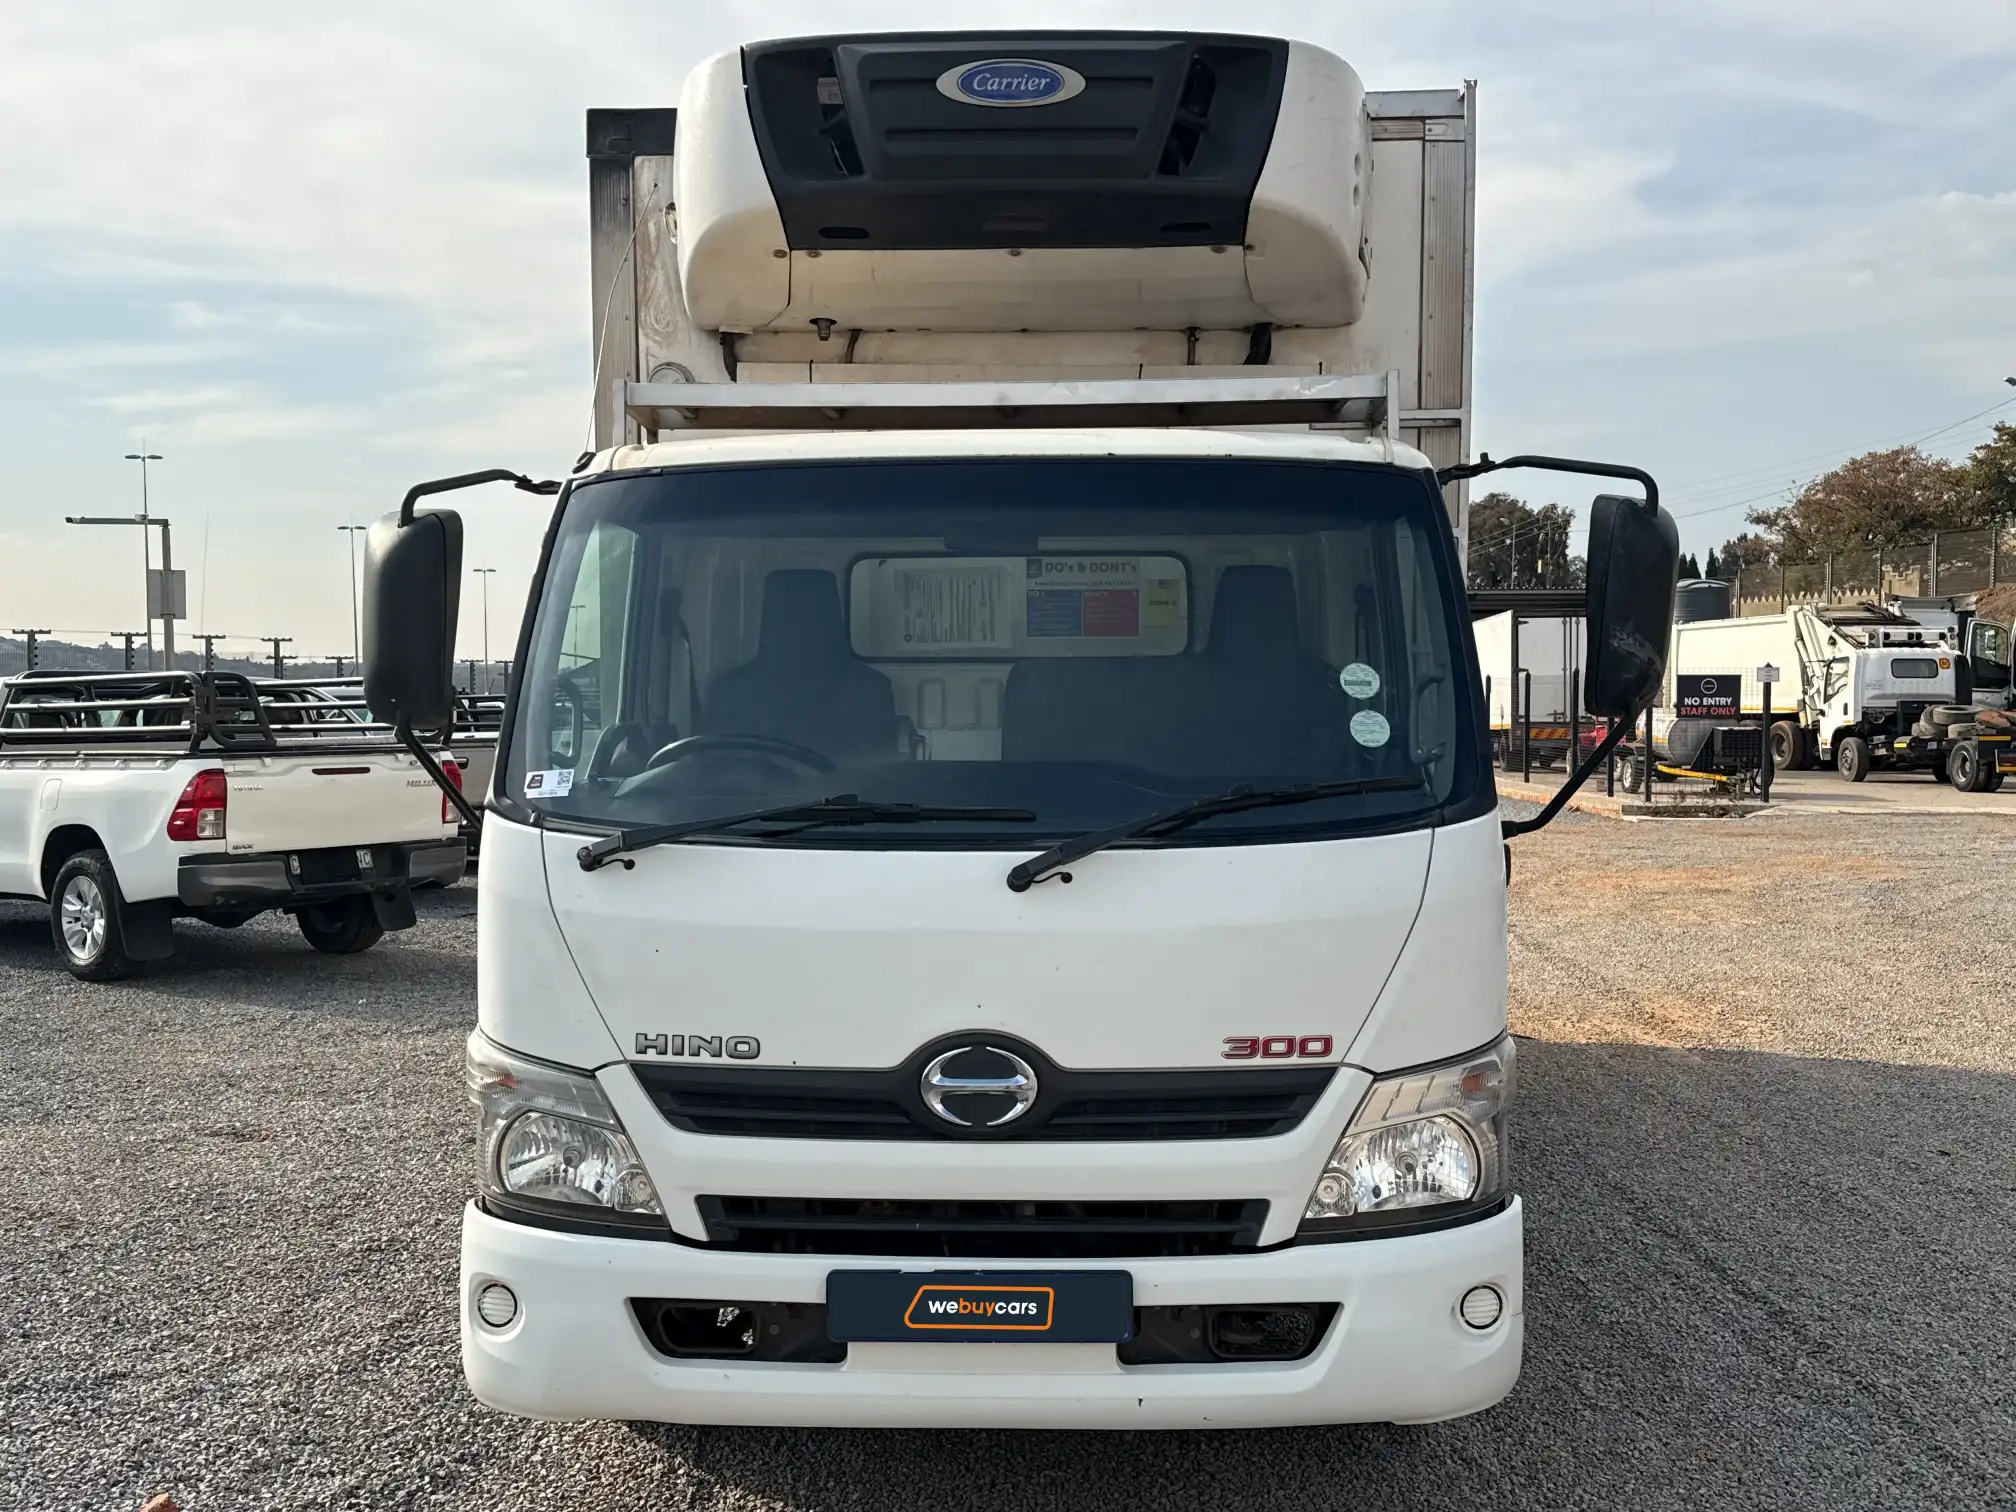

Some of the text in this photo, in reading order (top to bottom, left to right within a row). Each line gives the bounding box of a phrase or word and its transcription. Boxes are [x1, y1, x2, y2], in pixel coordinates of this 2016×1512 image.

[972, 73, 1050, 91] Carrier
[1045, 562, 1075, 573] DO's
[1684, 697, 1733, 706] NO ENTRY
[1680, 707, 1736, 715] STAFF ONLY
[635, 1032, 761, 1060] HINO
[1220, 1034, 1333, 1060] 300
[927, 1297, 1038, 1317] webuycars
